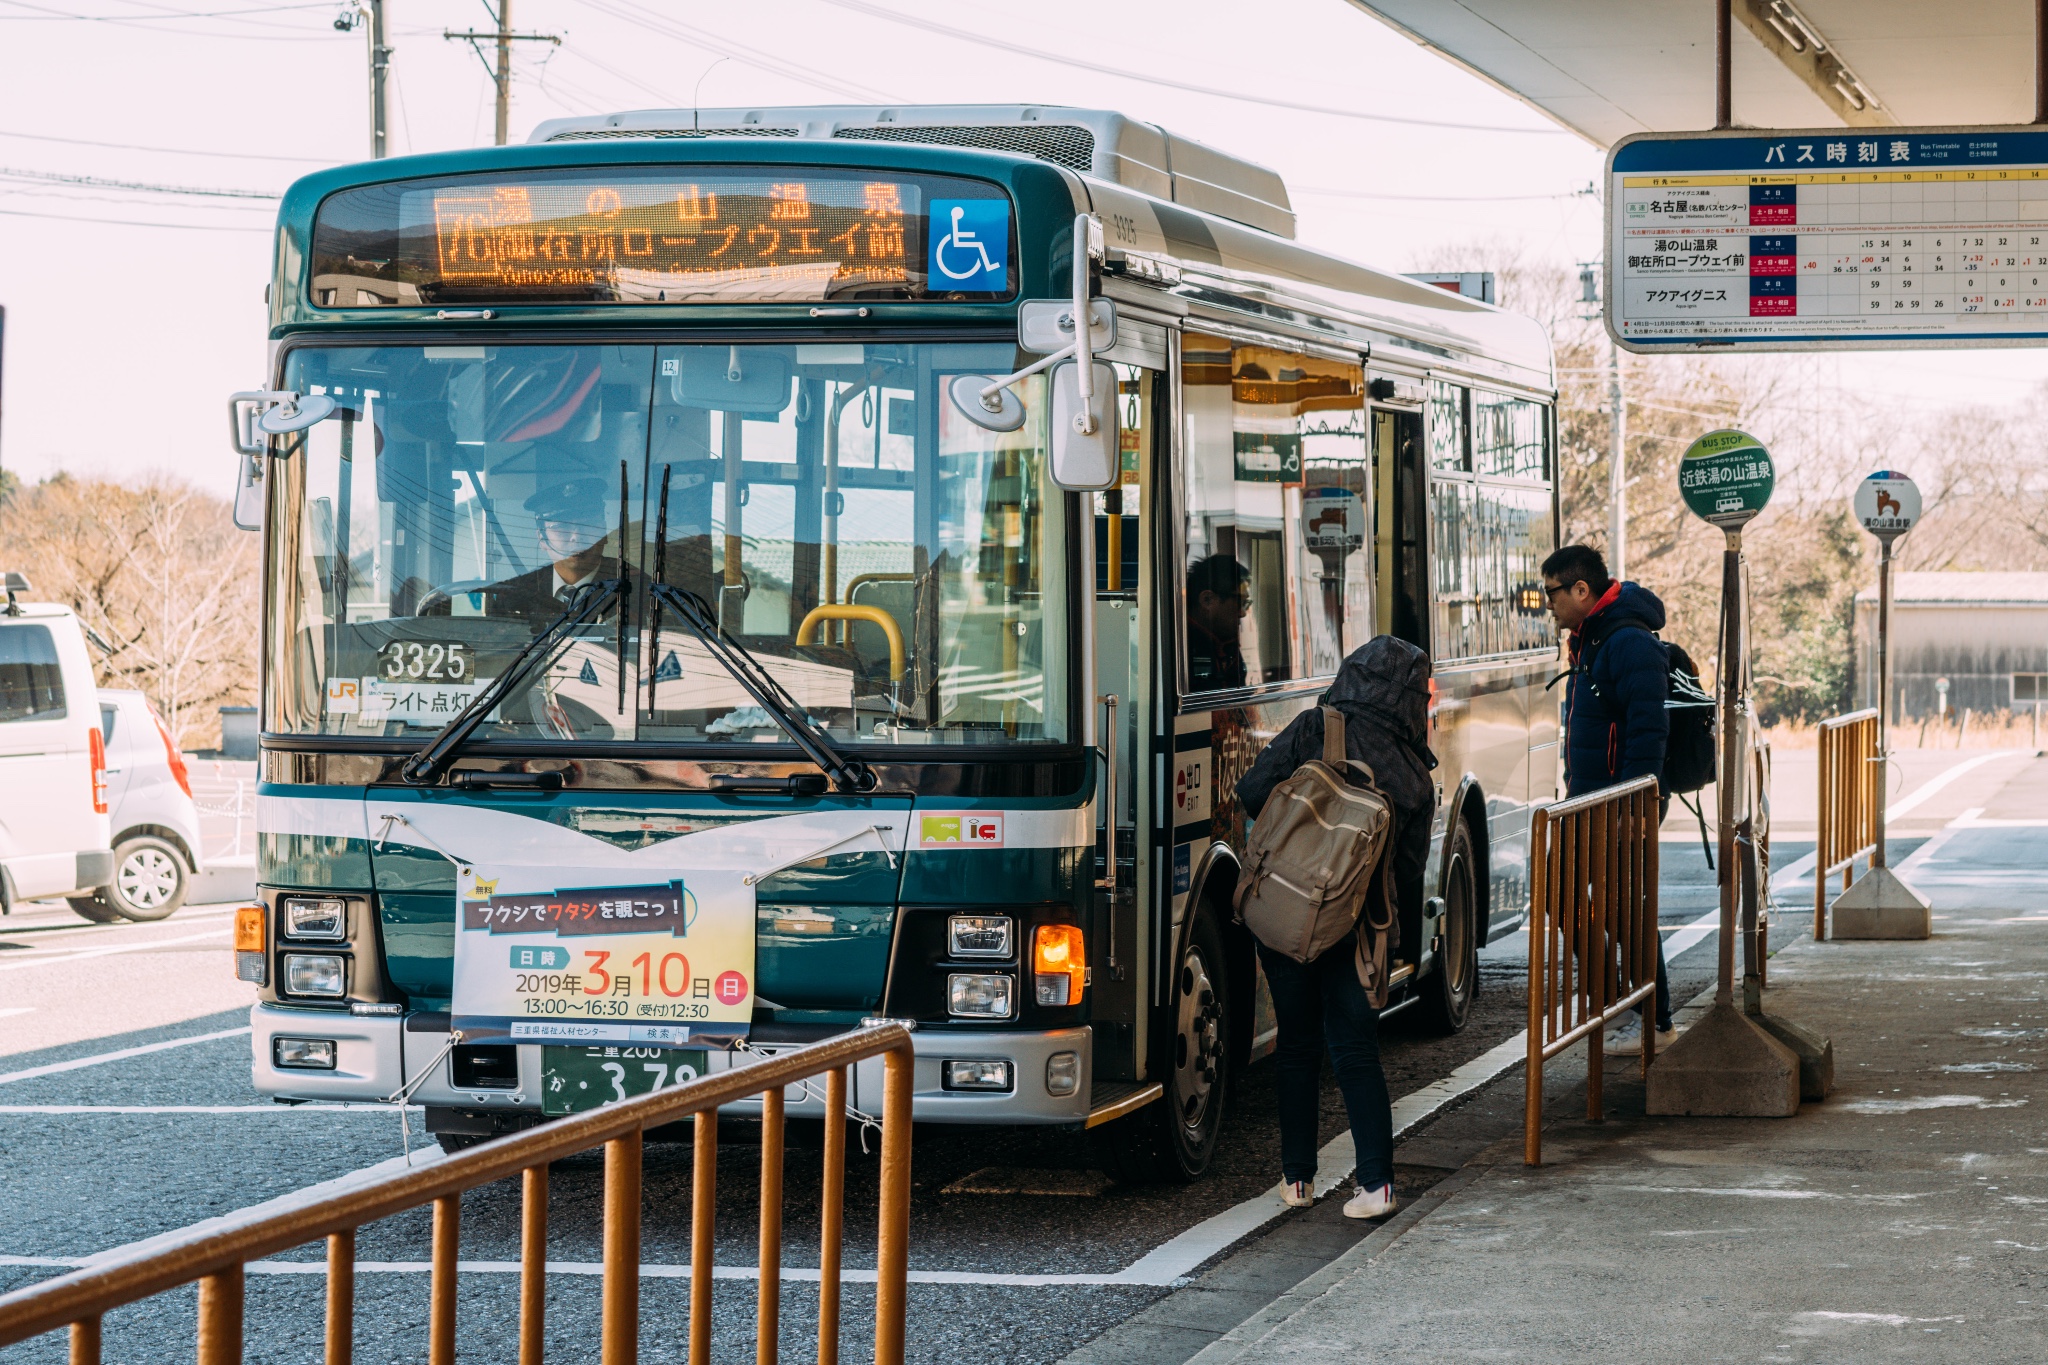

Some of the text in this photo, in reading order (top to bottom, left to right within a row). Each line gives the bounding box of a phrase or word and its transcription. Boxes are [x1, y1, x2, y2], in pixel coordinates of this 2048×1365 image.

[1765, 141, 1910, 163] バス時刻表
[494, 183, 903, 221] 湯の山温泉
[1114, 214, 1137, 245] 3325
[1655, 239, 1718, 252] 湯の山温泉
[1628, 254, 1745, 268] 御在所ロープウェイ前
[1646, 289, 1727, 302] アクアイグニス
[664, 361, 674, 371] 12
[1702, 435, 1743, 448] BUS STOP
[1681, 460, 1771, 488] 近鉄湯の山温泉
[1863, 517, 1911, 528] 湯の山温泉駅
[387, 642, 465, 679] 3325
[329, 682, 357, 699] JR
[1186, 763, 1200, 790] 出口
[1187, 795, 1199, 811] EXIT
[475, 885, 493, 895] 無料
[478, 899, 680, 923] フクシでワタシを覗こっ！
[520, 950, 555, 966] 日時
[514, 1025, 670, 1039] 三重県福祉人材センター 検索
